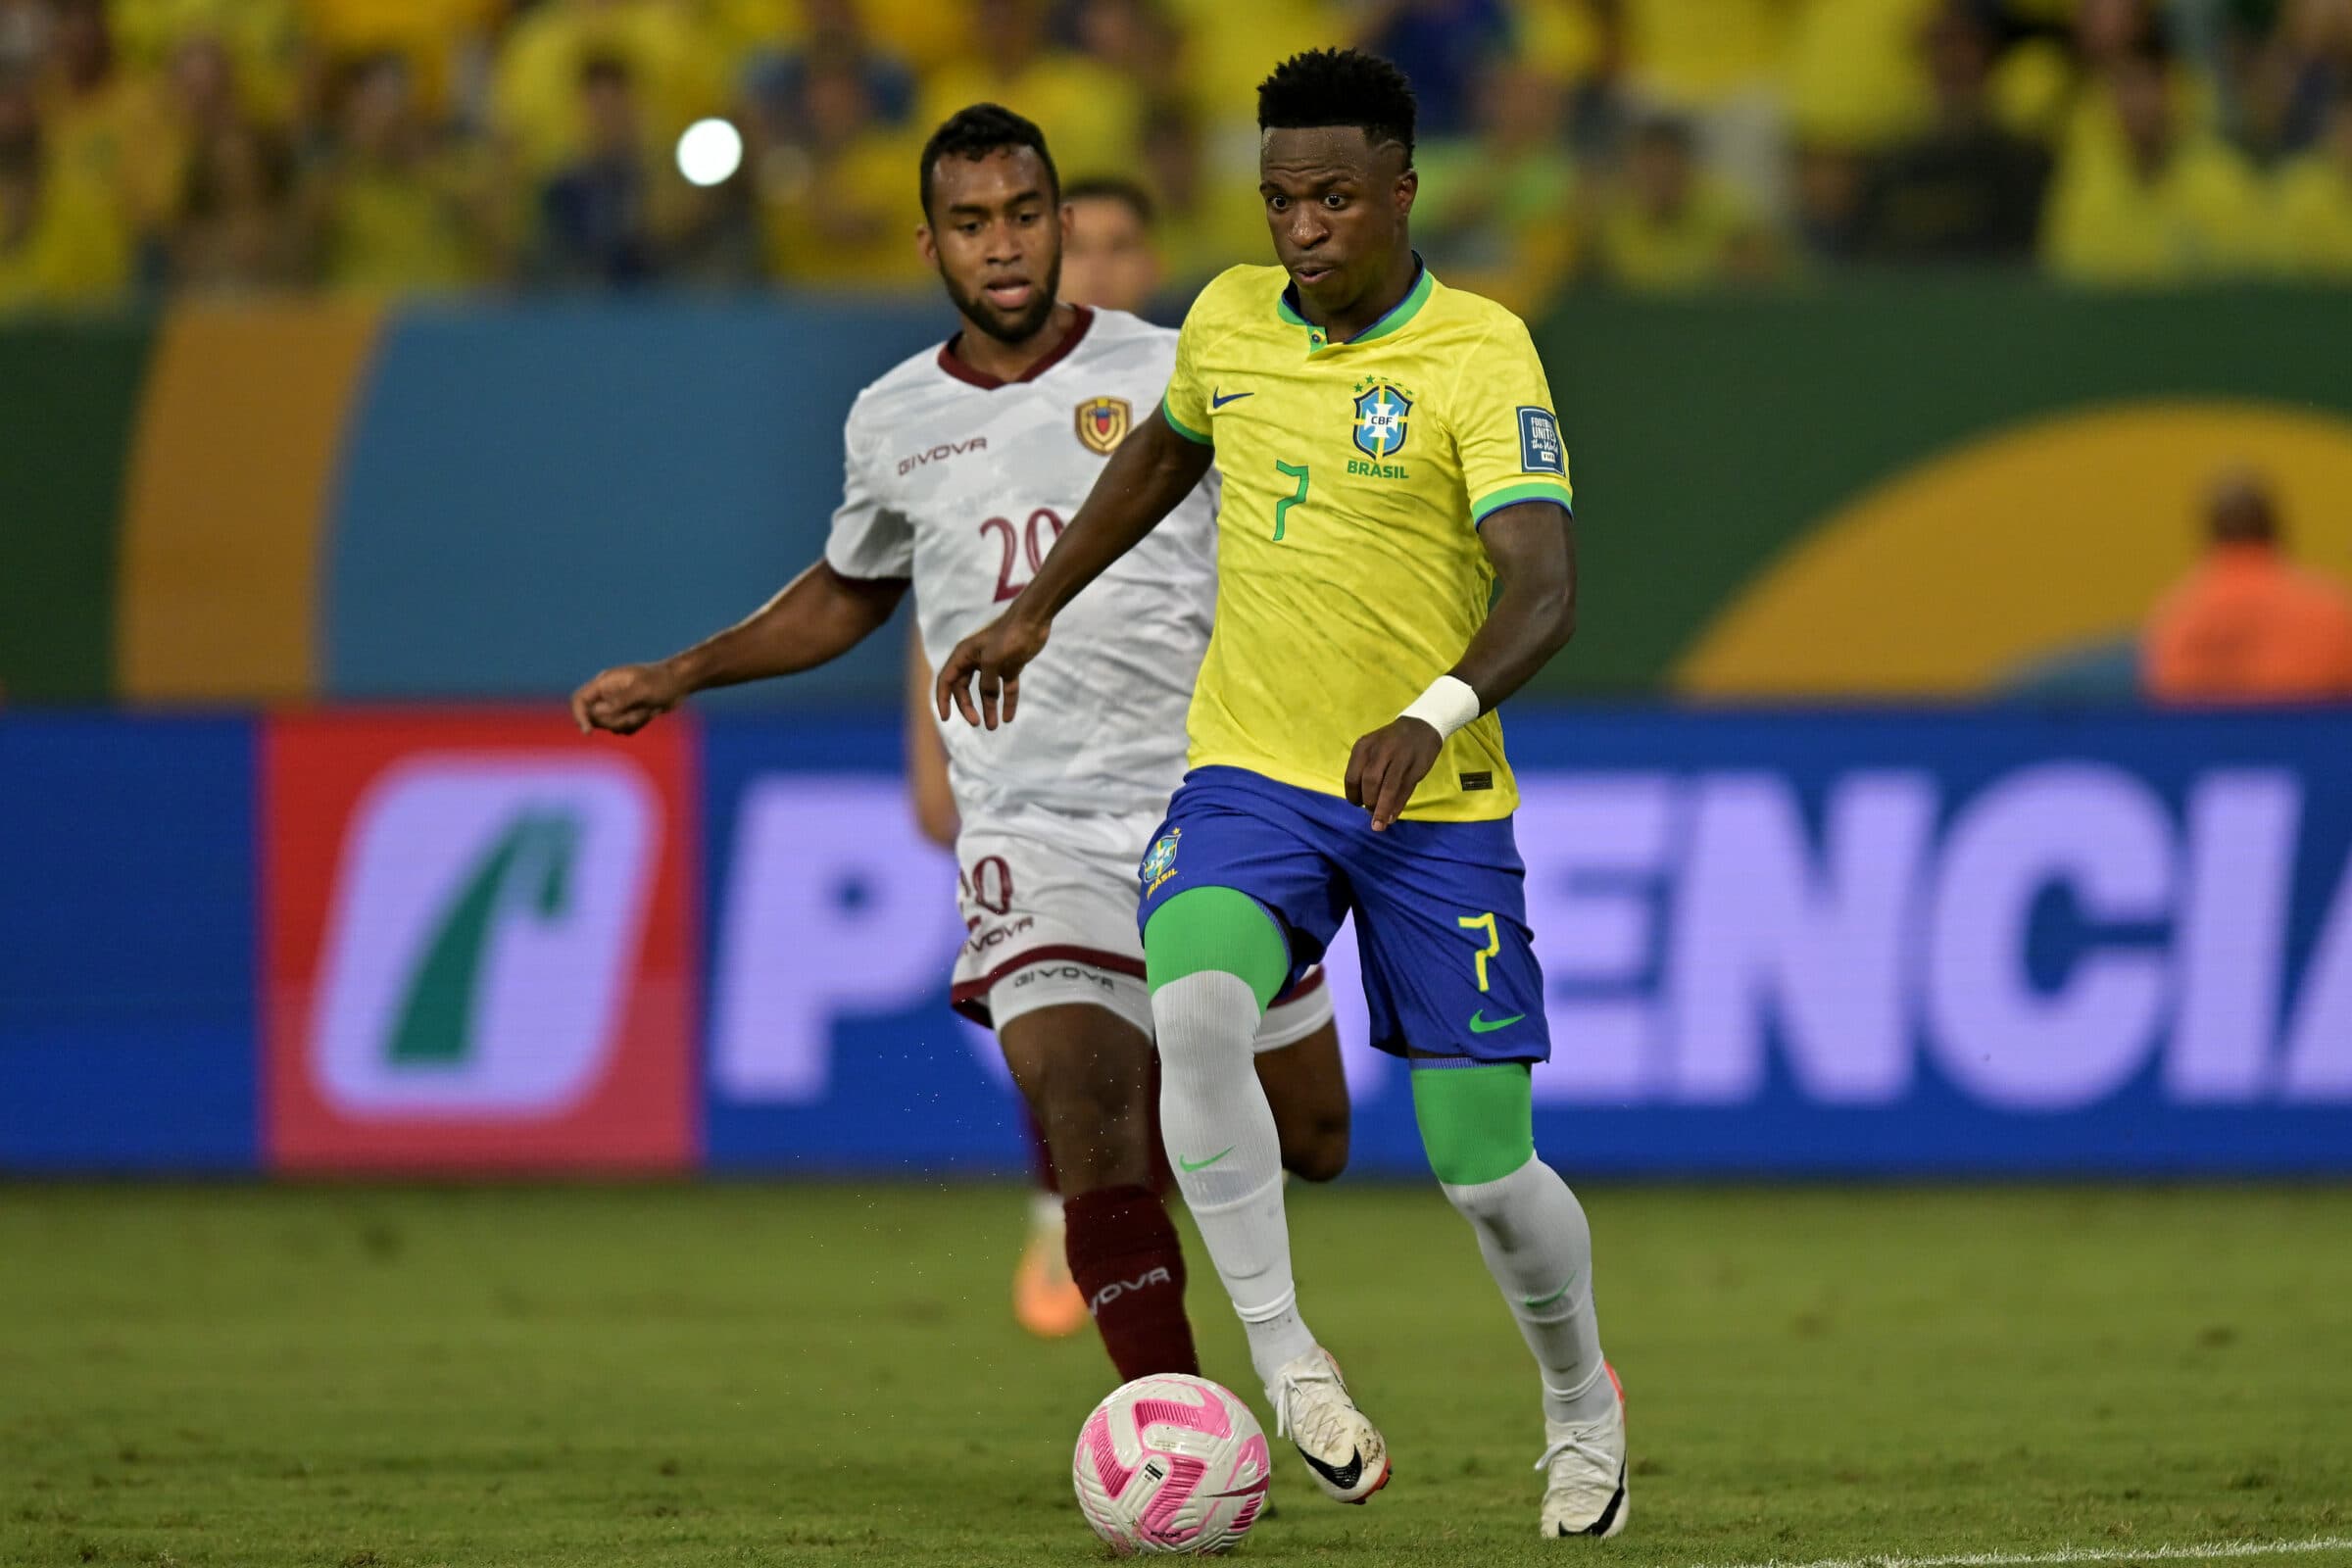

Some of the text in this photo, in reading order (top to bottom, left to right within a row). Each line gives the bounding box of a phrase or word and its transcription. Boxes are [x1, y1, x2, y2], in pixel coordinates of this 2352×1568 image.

[1370, 416, 1394, 425] CBF
[898, 437, 987, 476] GIVOVA
[1348, 460, 1409, 479] BRASIL
[1273, 459, 1309, 541] 7
[980, 508, 1066, 603] 20
[1458, 912, 1500, 992] 7
